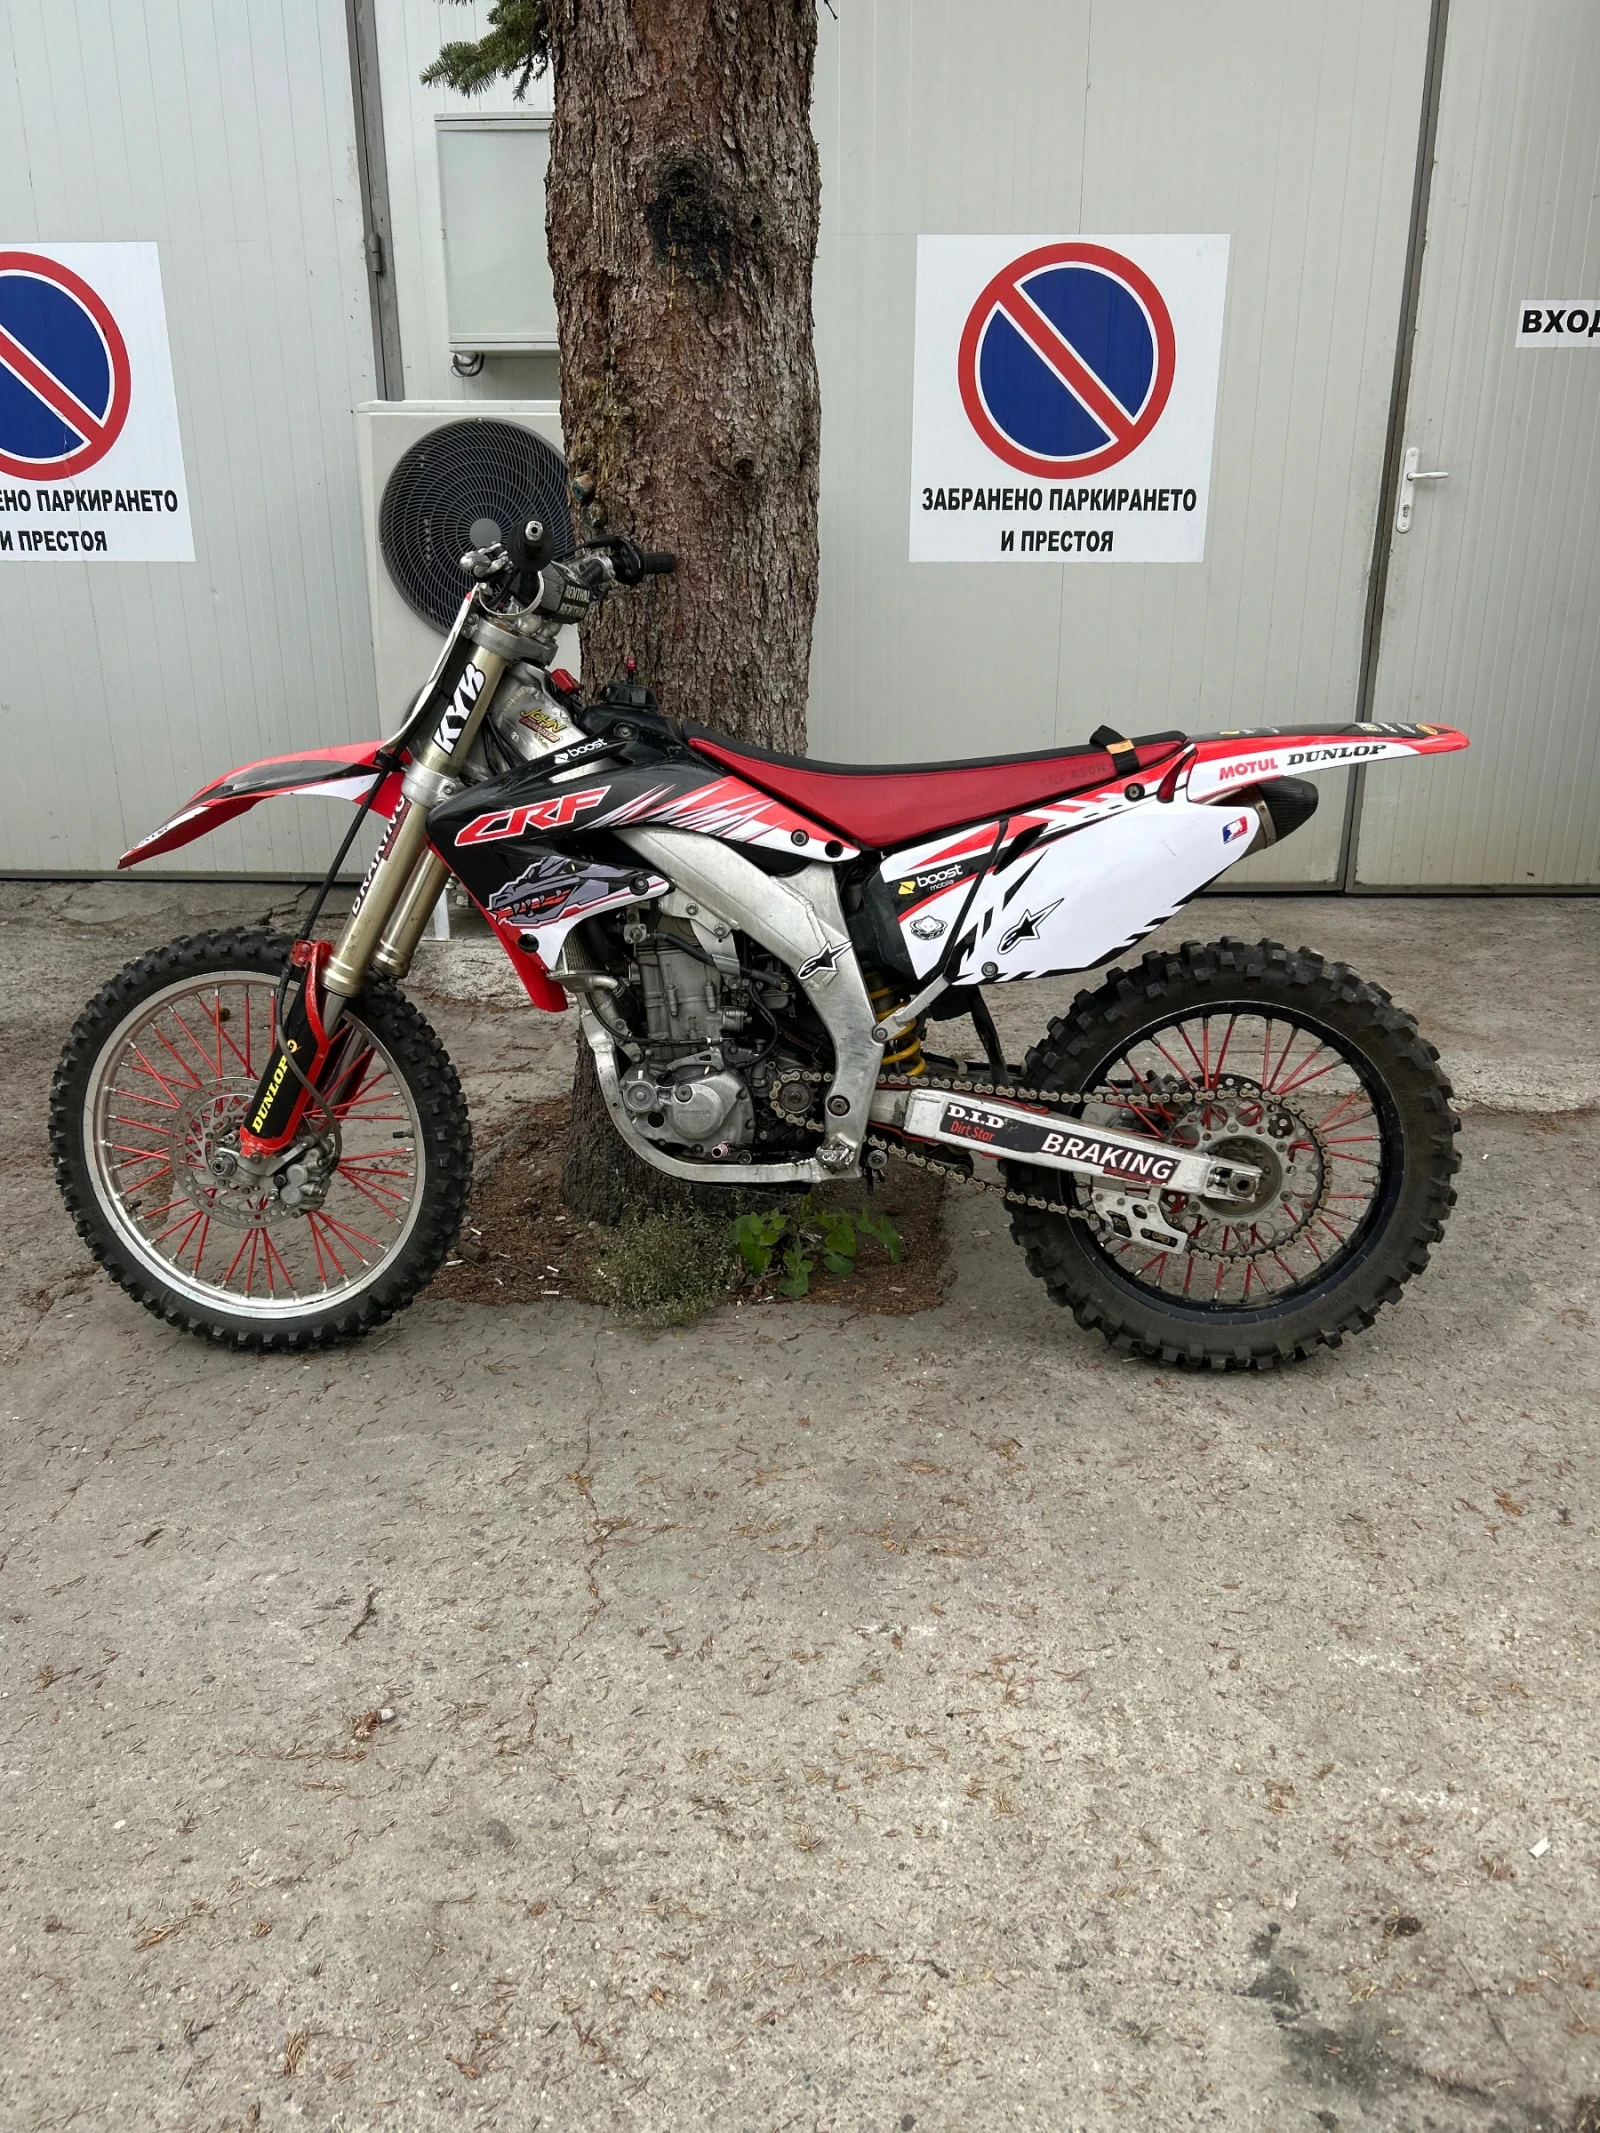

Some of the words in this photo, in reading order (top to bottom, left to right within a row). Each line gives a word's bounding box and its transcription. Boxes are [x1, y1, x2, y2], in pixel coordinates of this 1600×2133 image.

[36, 489, 178, 512] ПАРКИРАНЕТО
[922, 488, 1043, 511] ЗАБРАНЕНО
[1049, 488, 1197, 512] ПАРКИРАНЕТО
[0, 530, 13, 551] И
[18, 530, 108, 552] ПРЕСТОЯ
[1001, 530, 1014, 551] И
[1021, 530, 1113, 552] ПРЕСТОЯ
[433, 662, 486, 756] KYB
[520, 708, 567, 733] JOHN
[568, 737, 608, 757] boost
[1287, 745, 1387, 766] DUNLOP
[1219, 758, 1278, 781] MOTUL
[454, 785, 612, 847] CRF
[916, 864, 963, 888] boost
[930, 880, 954, 891] mobile
[252, 1055, 289, 1133] DUNLOP
[947, 1104, 1004, 1129] D.I.D
[951, 1120, 971, 1136] Dirt
[972, 1126, 995, 1142] Star
[1041, 1132, 1173, 1180] BRAKING
